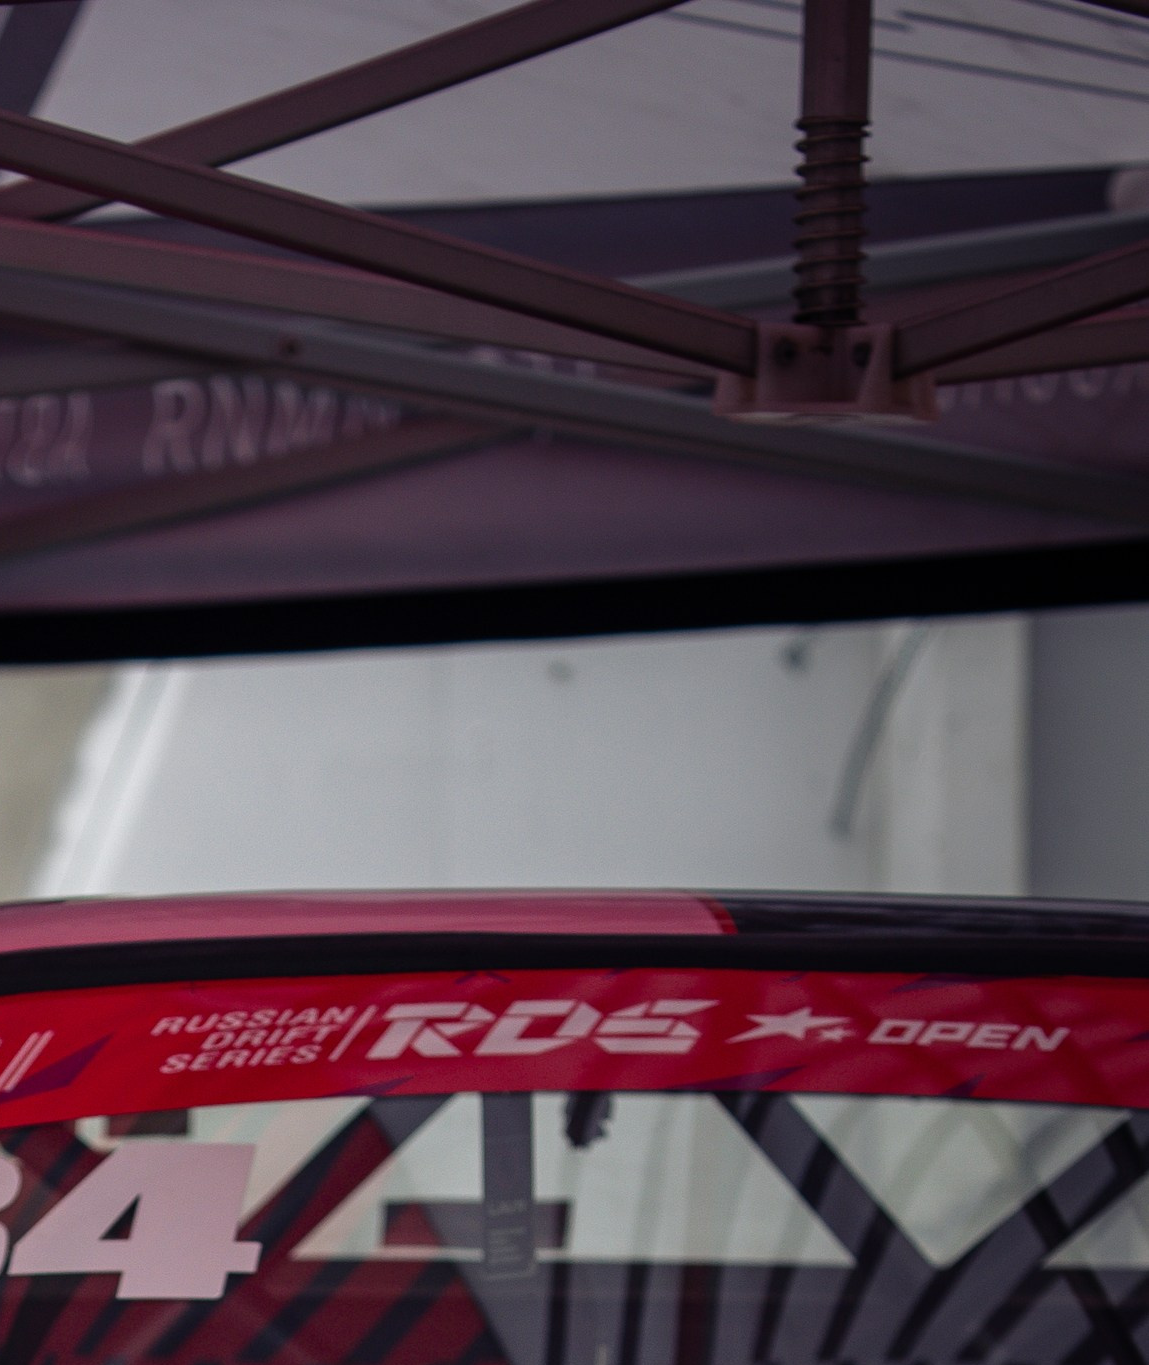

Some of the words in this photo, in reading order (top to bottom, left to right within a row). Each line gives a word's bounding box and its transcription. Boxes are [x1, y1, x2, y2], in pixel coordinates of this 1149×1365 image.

[150, 1006, 356, 1036] RUSSIAN
[365, 1000, 721, 1060] RDS
[866, 1018, 1070, 1051] OPEN
[200, 1024, 342, 1051] DRIFT
[159, 1045, 323, 1075] SERIES
